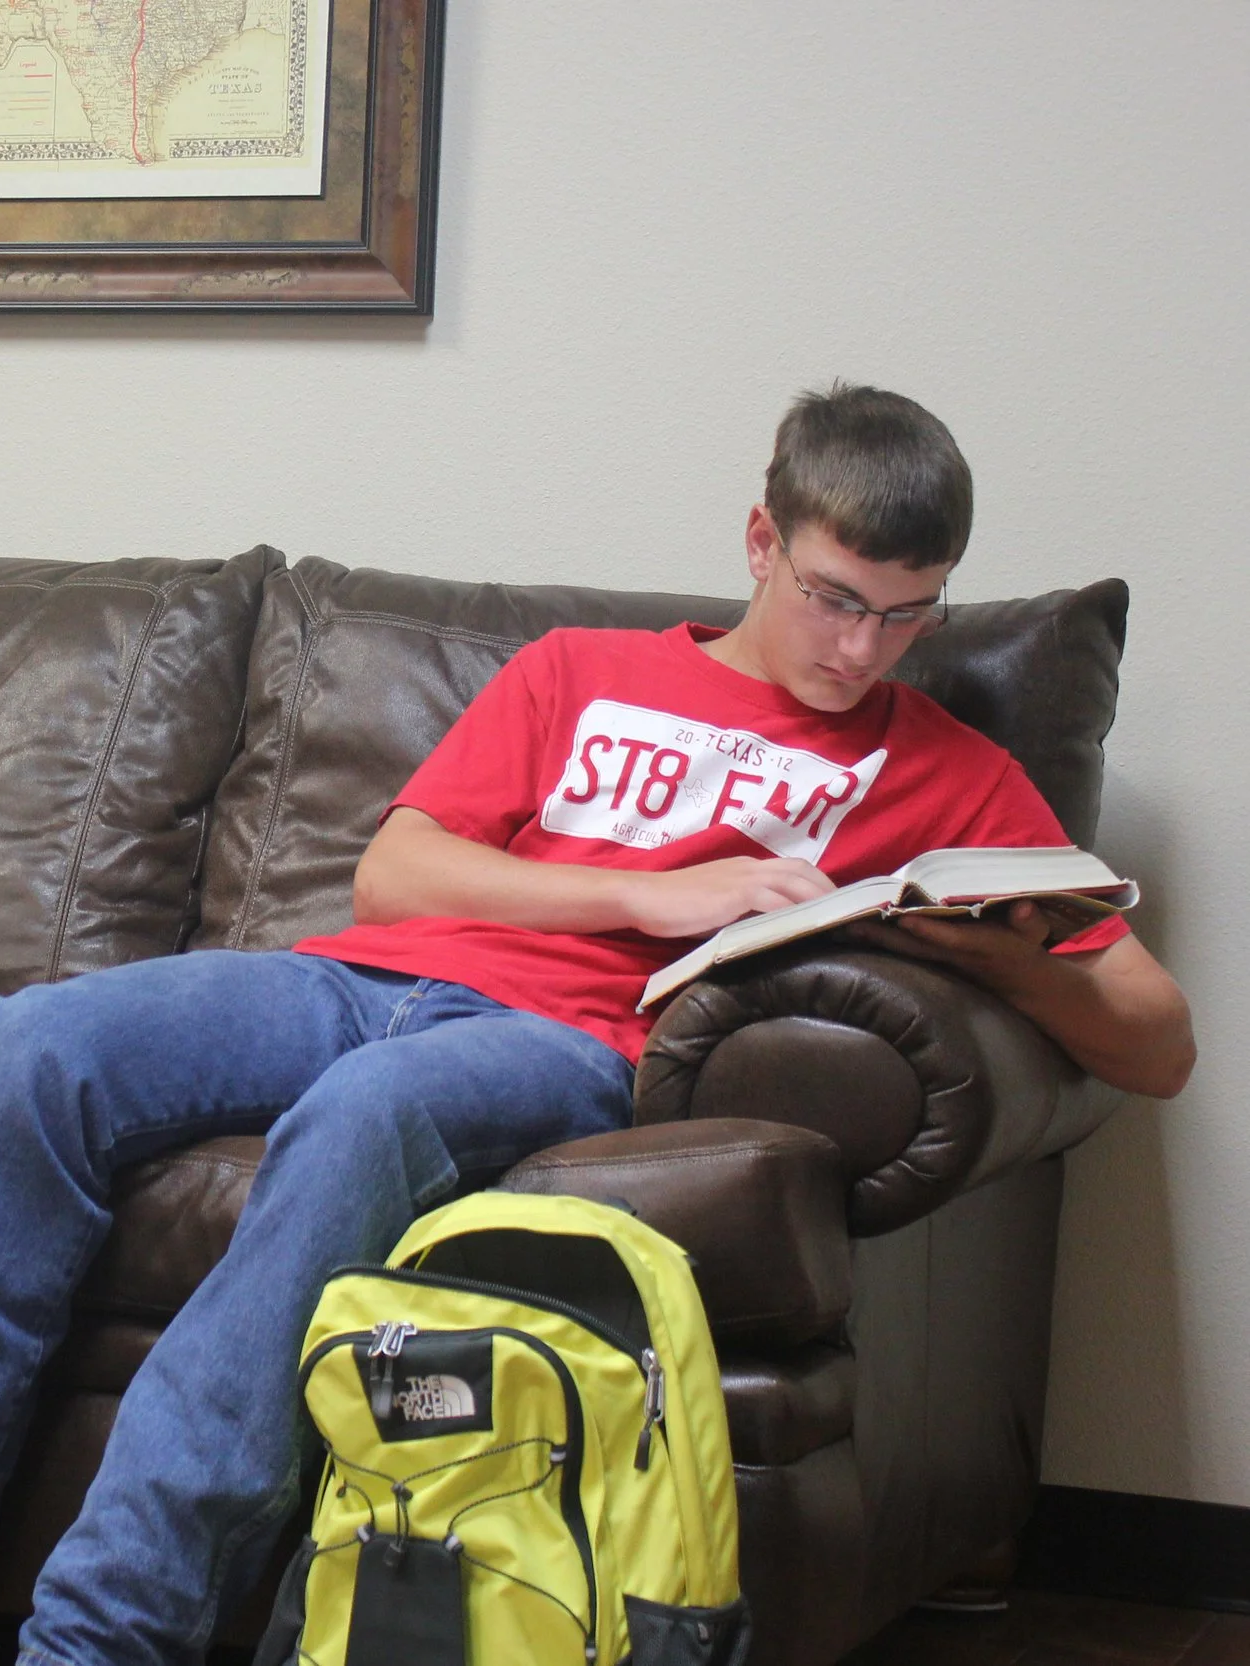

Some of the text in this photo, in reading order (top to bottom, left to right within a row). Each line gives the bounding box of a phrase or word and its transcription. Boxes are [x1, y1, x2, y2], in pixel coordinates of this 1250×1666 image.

[562, 735, 692, 820] ST8
[405, 1375, 442, 1391] THE
[403, 1405, 445, 1421] FACE
